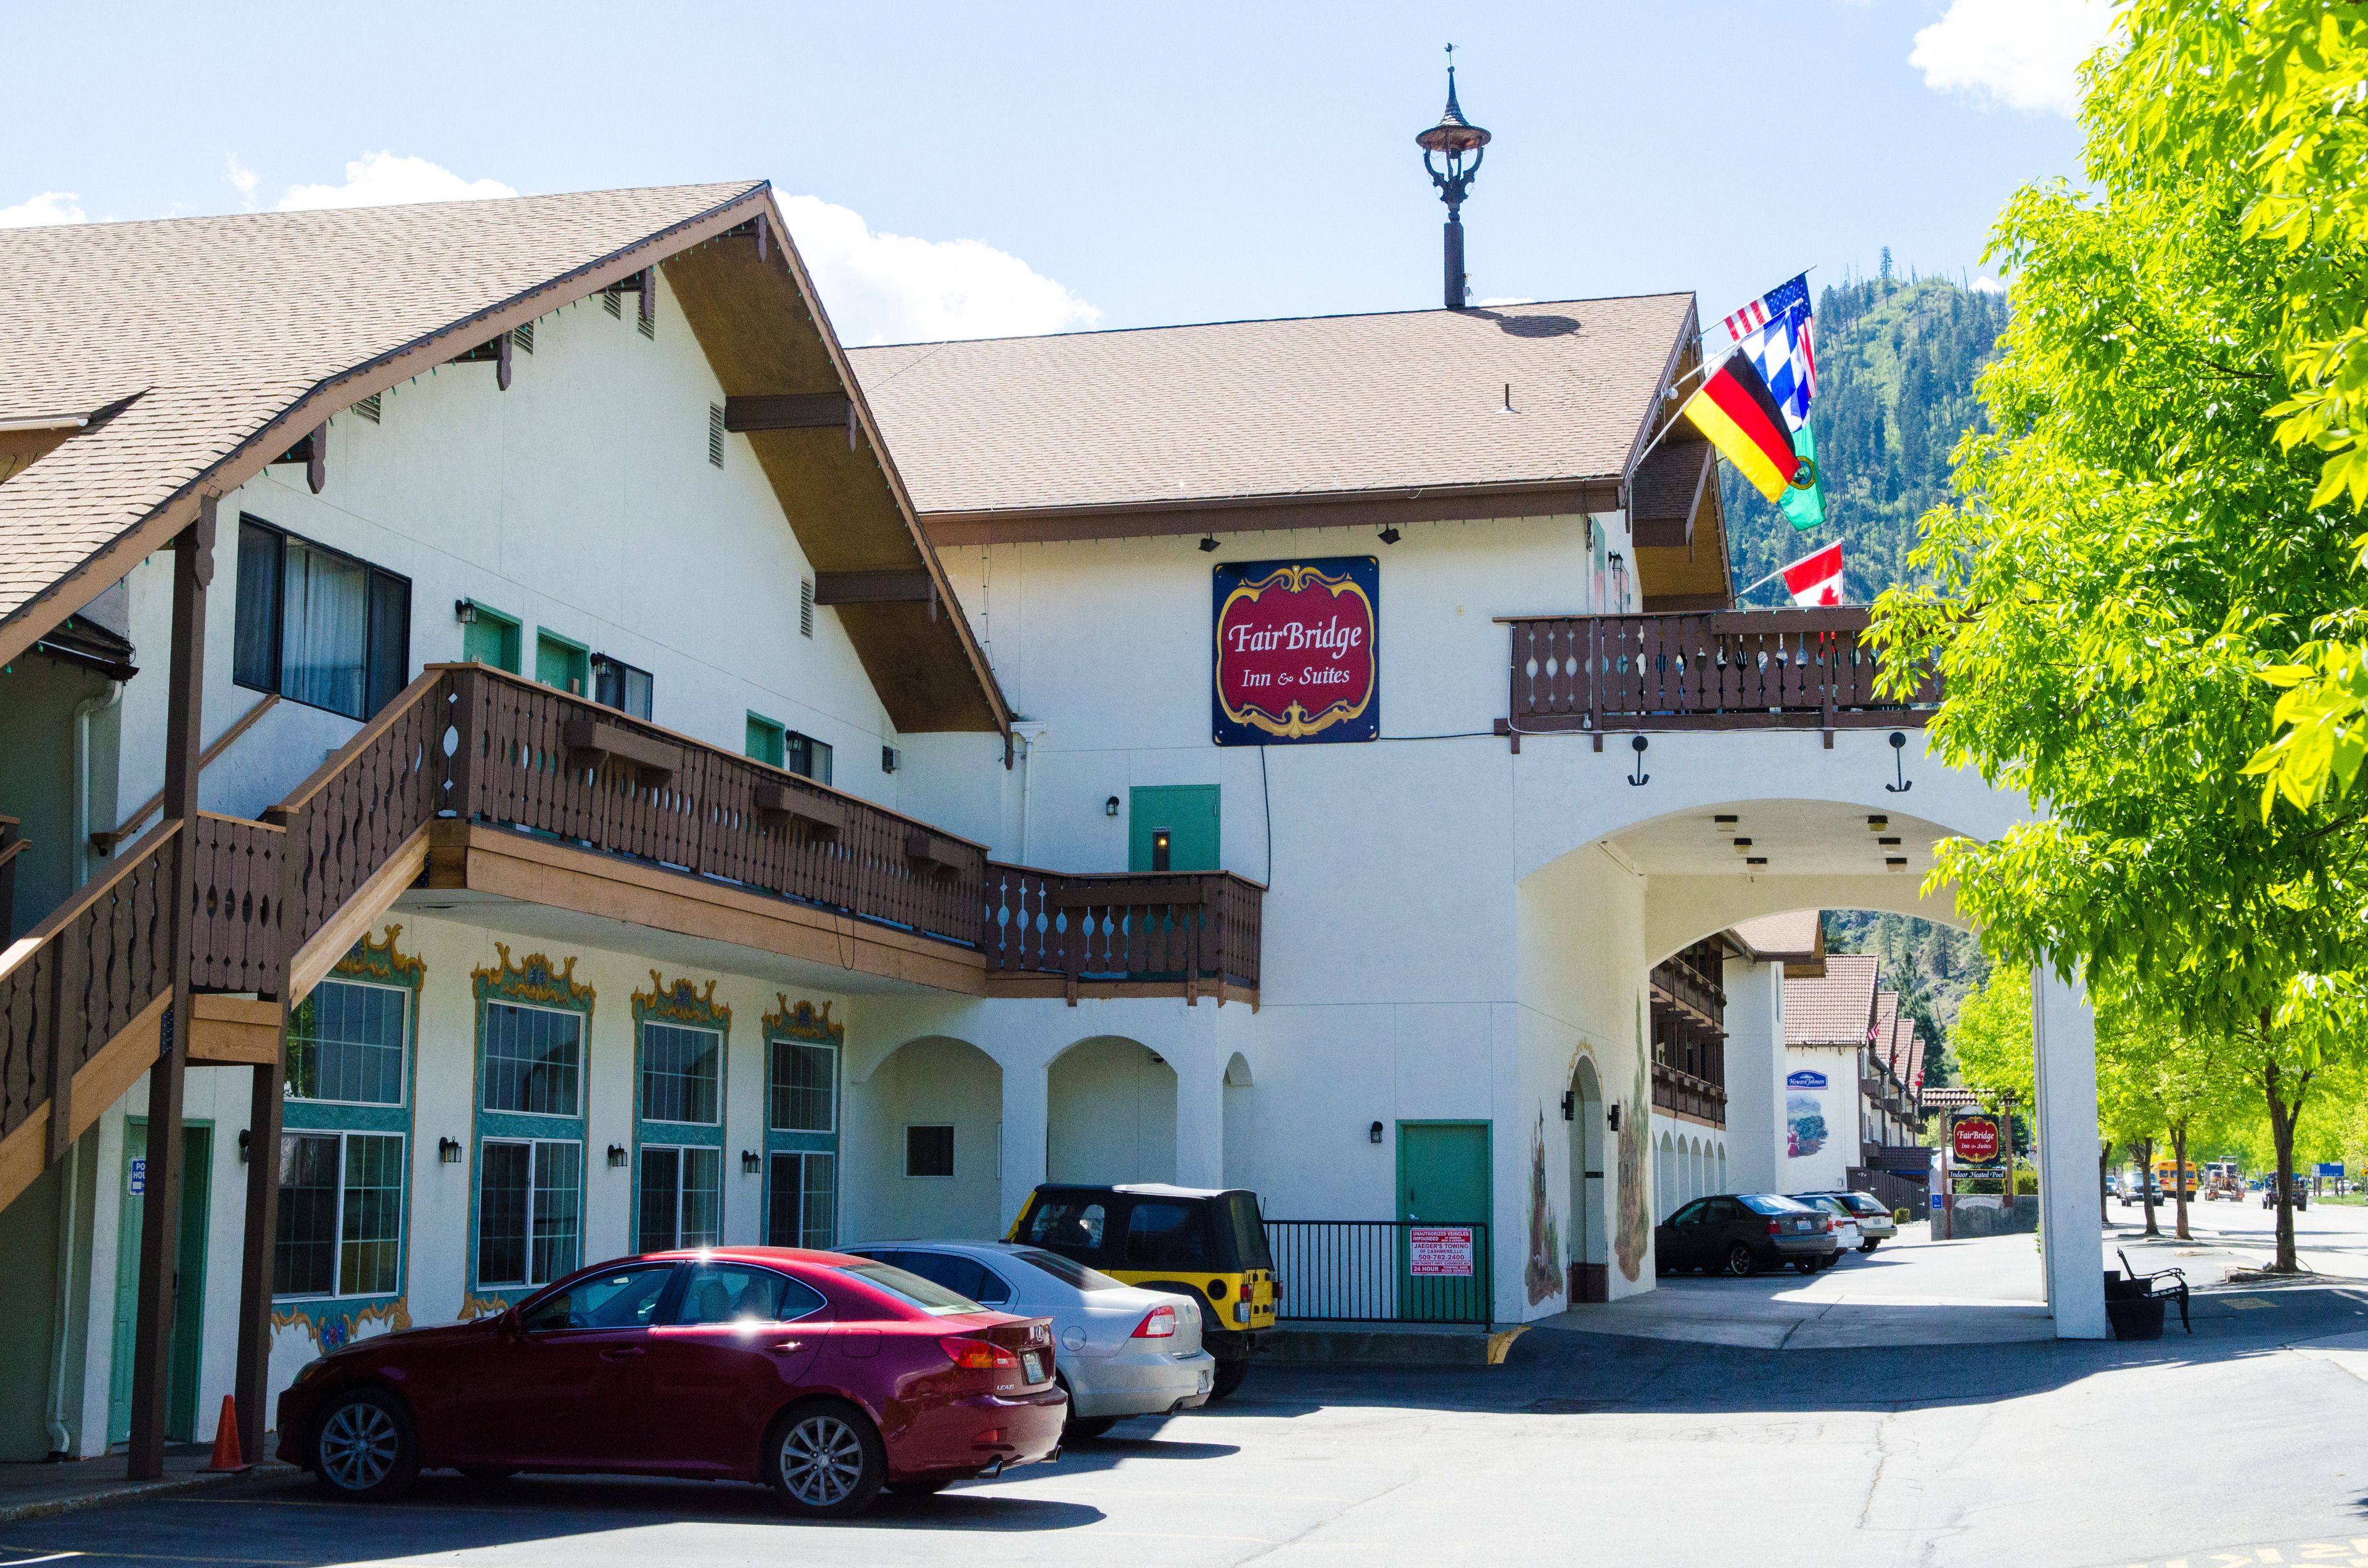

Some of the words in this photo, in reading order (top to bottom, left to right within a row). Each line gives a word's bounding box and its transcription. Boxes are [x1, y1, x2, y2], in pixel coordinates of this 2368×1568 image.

[1228, 615, 1362, 659] FairBridge
[1241, 670, 1271, 687] Inn
[1278, 672, 1294, 686] &
[1299, 667, 1350, 685] Suites
[1957, 1130, 1994, 1143] FairBridge
